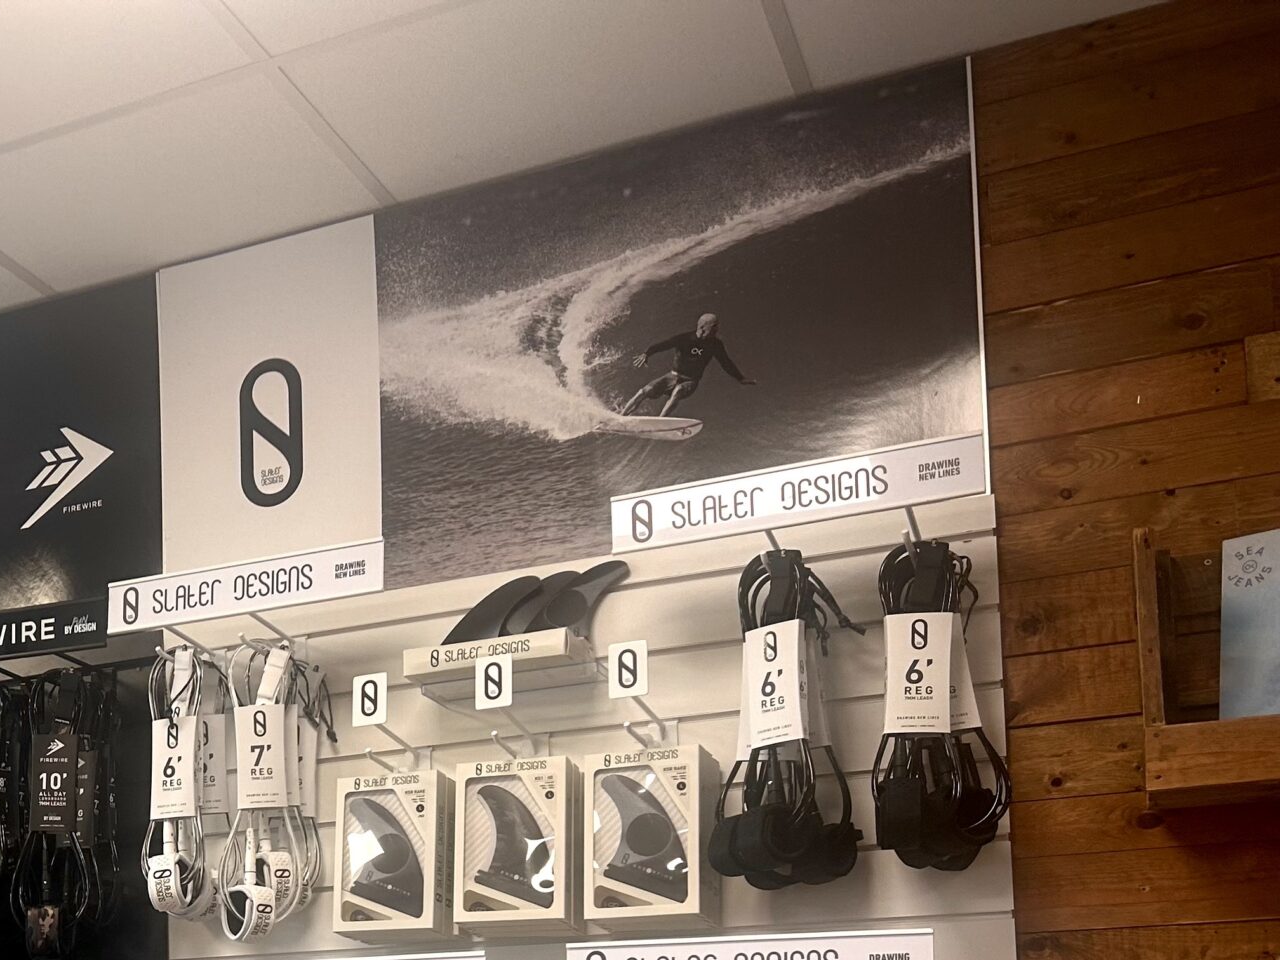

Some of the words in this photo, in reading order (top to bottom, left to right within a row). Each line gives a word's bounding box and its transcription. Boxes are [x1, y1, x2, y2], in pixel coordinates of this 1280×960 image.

[918, 457, 960, 473] DRAWING
[918, 470, 937, 482] NEW
[938, 467, 960, 479] LINES
[781, 464, 888, 511] DESIGNS
[62, 499, 103, 514] FIREWIRE
[1234, 545, 1265, 561] SEA
[334, 559, 366, 572] DRAWING
[334, 570, 348, 580] NEW
[349, 567, 366, 577] LINES
[233, 563, 313, 601] DESIGNS
[1227, 565, 1273, 588] JEANS
[64, 624, 73, 635] BY
[73, 621, 97, 634] DESIGN
[905, 658, 933, 685] 6'
[761, 668, 783, 697] 6'
[904, 685, 934, 696] REG
[761, 695, 785, 709] REG
[250, 744, 272, 766] 7'
[163, 755, 182, 778] 6'
[250, 767, 273, 776] REG
[39, 772, 68, 790] 10'
[162, 778, 182, 788] REG
